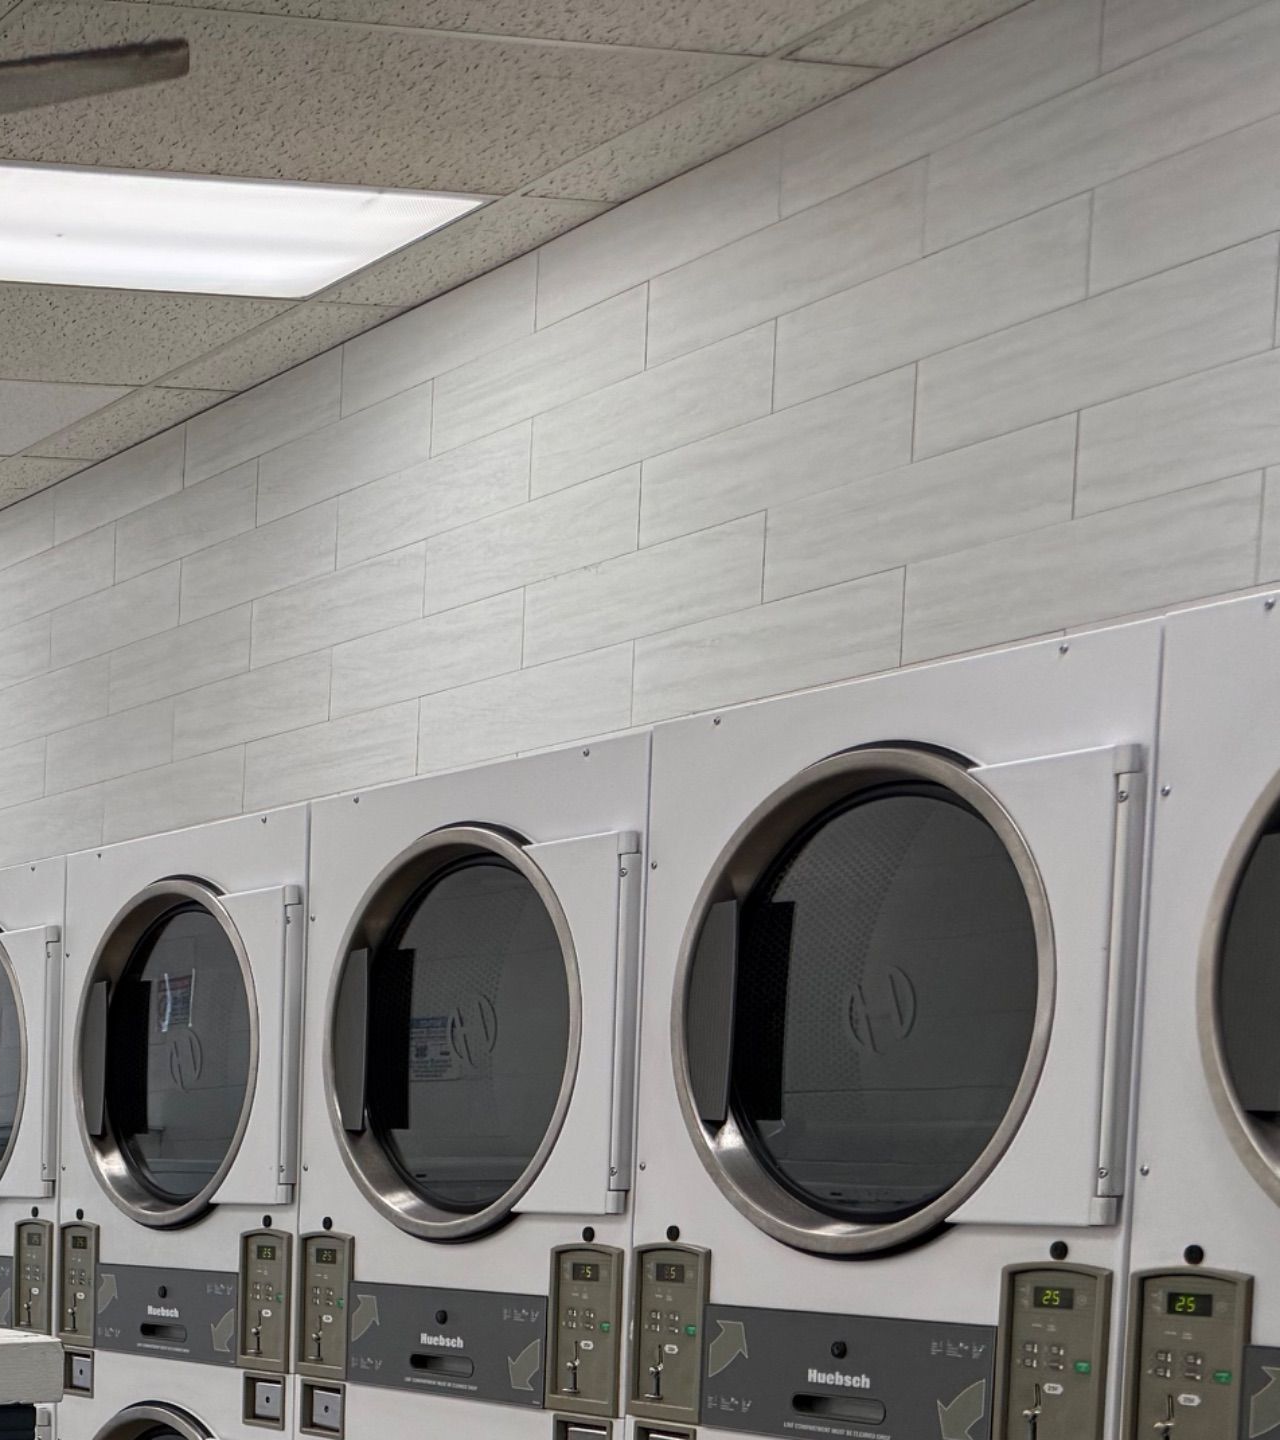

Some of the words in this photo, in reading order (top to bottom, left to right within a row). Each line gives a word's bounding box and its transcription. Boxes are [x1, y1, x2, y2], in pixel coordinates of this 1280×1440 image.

[1042, 1290, 1060, 1305] 25
[1175, 1296, 1196, 1312] 25
[420, 1332, 464, 1349] Huebsch
[807, 1368, 871, 1390] Huebsch
